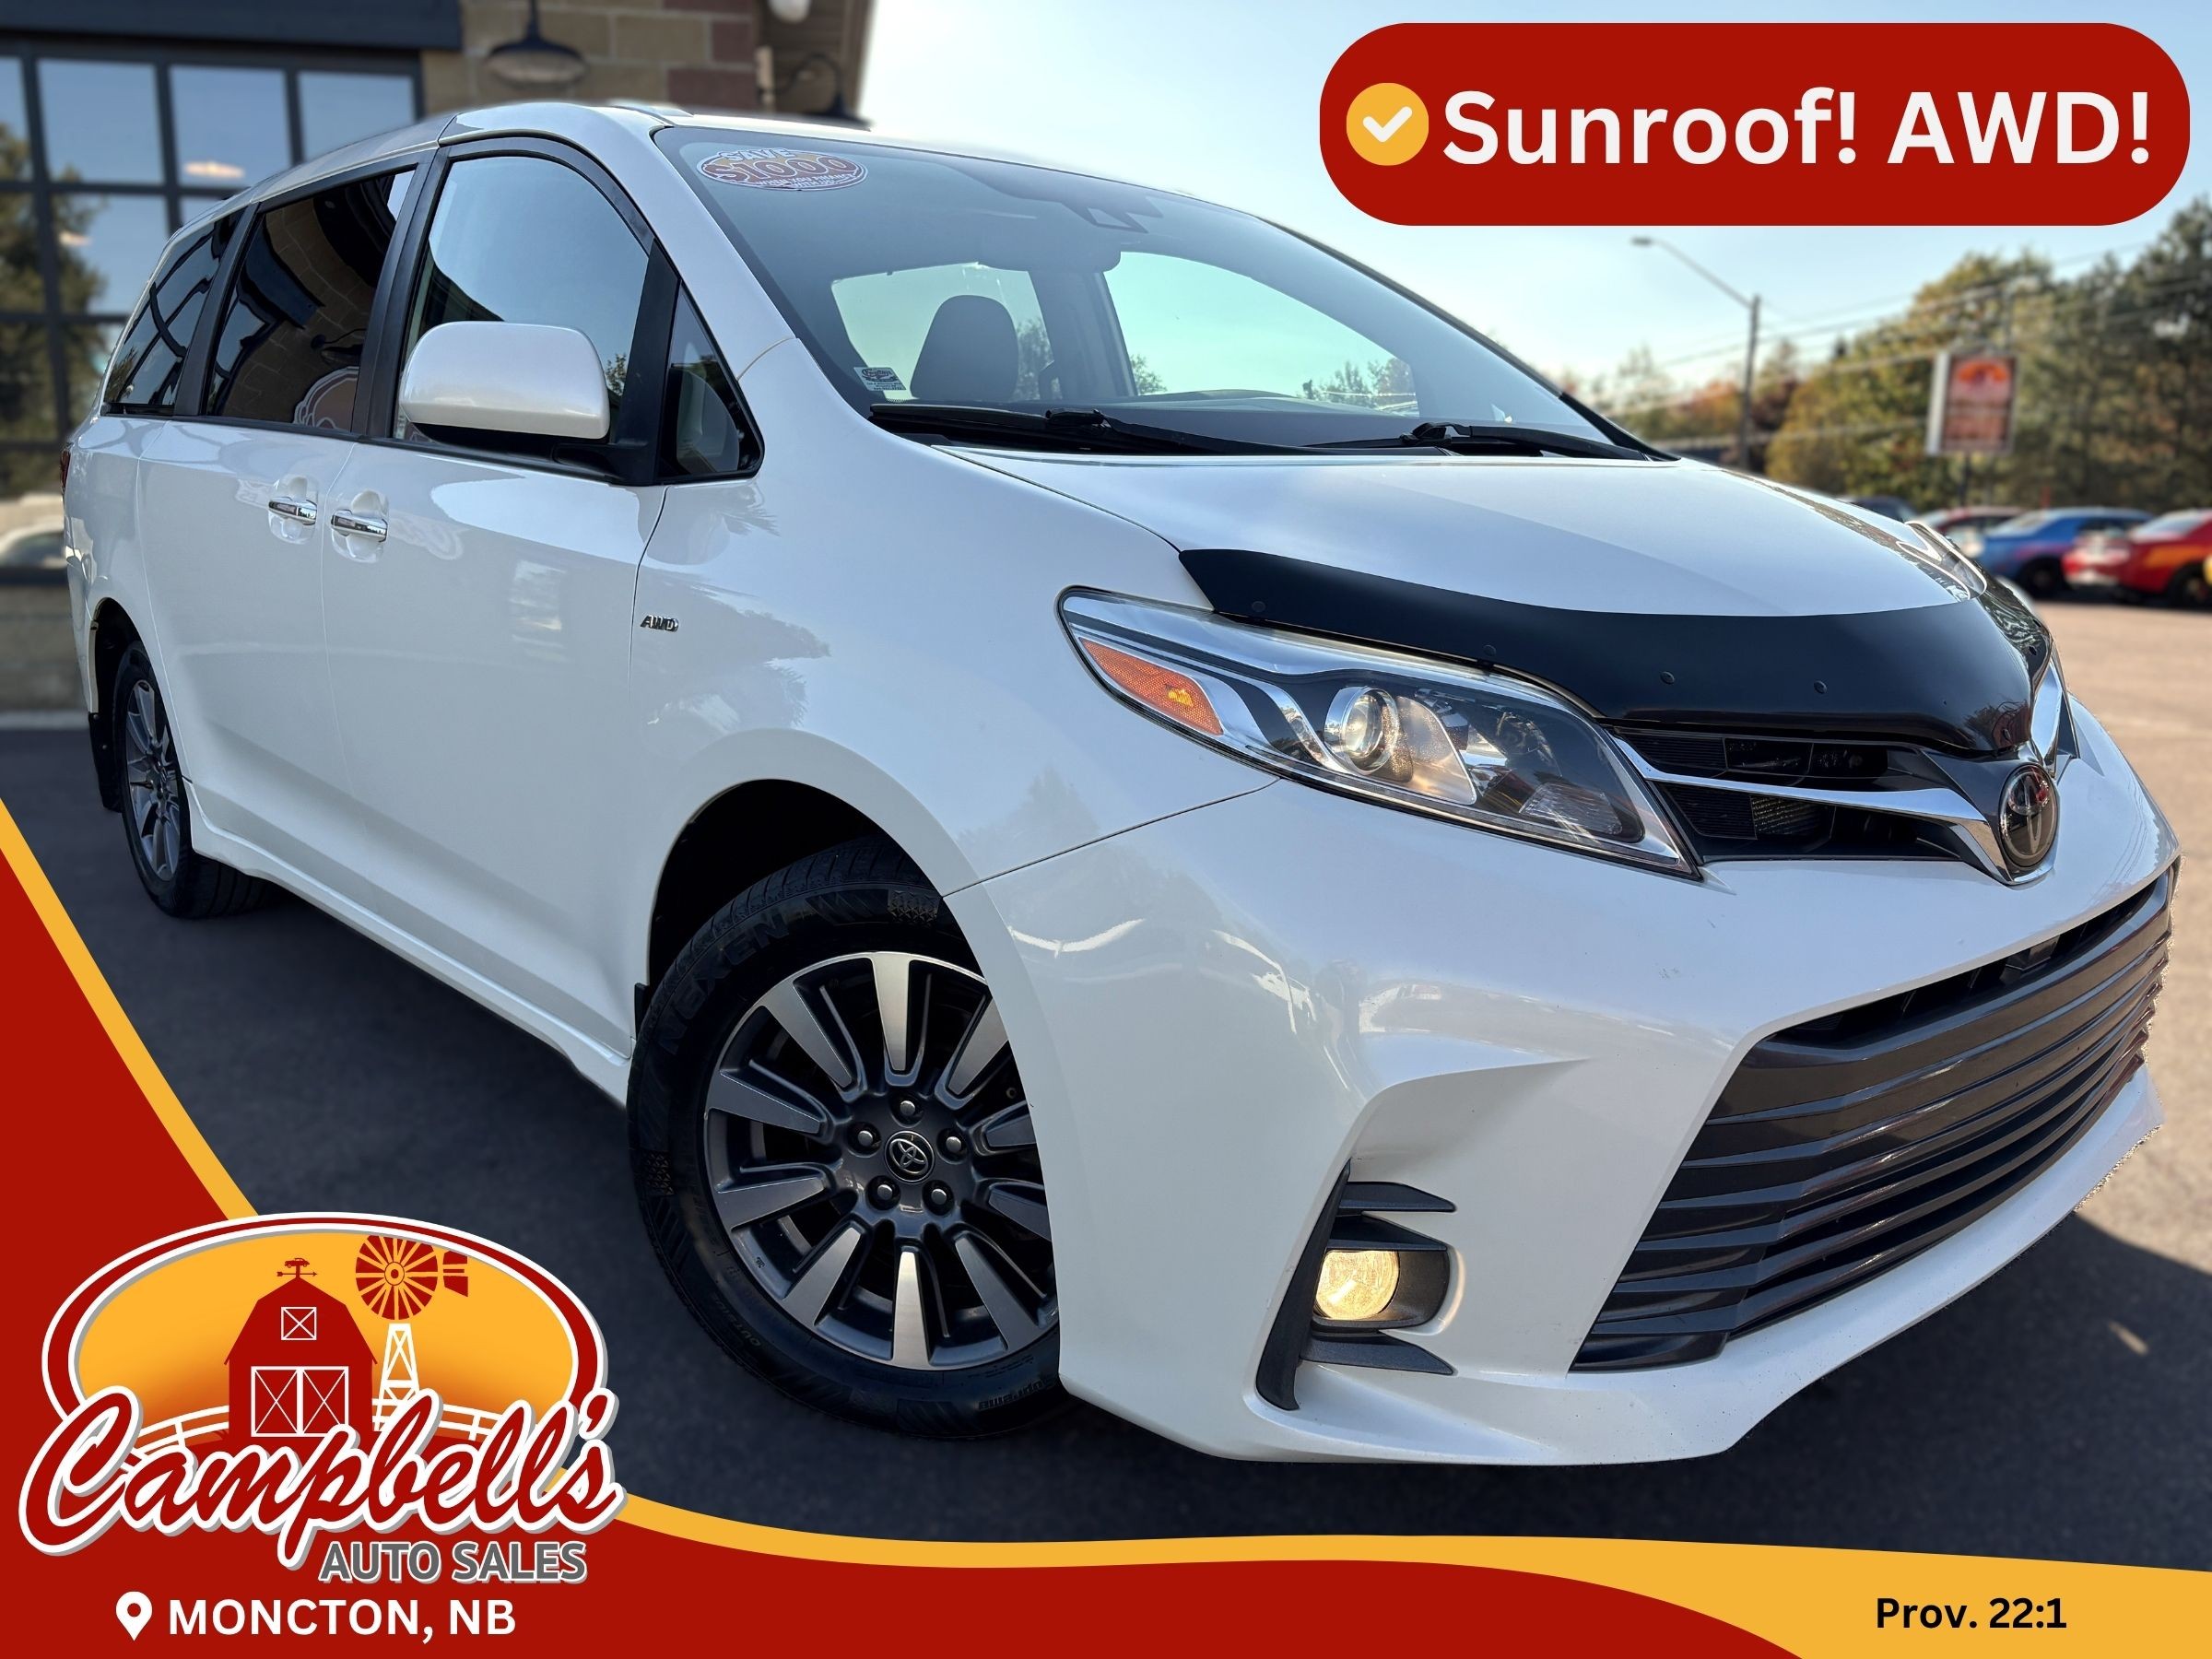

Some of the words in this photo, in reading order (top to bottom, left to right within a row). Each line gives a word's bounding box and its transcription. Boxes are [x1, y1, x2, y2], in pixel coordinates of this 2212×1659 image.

[724, 147, 795, 162] SAVE
[702, 155, 859, 185] $1000
[640, 614, 679, 632] AWD
[656, 908, 789, 1056] NEXEN
